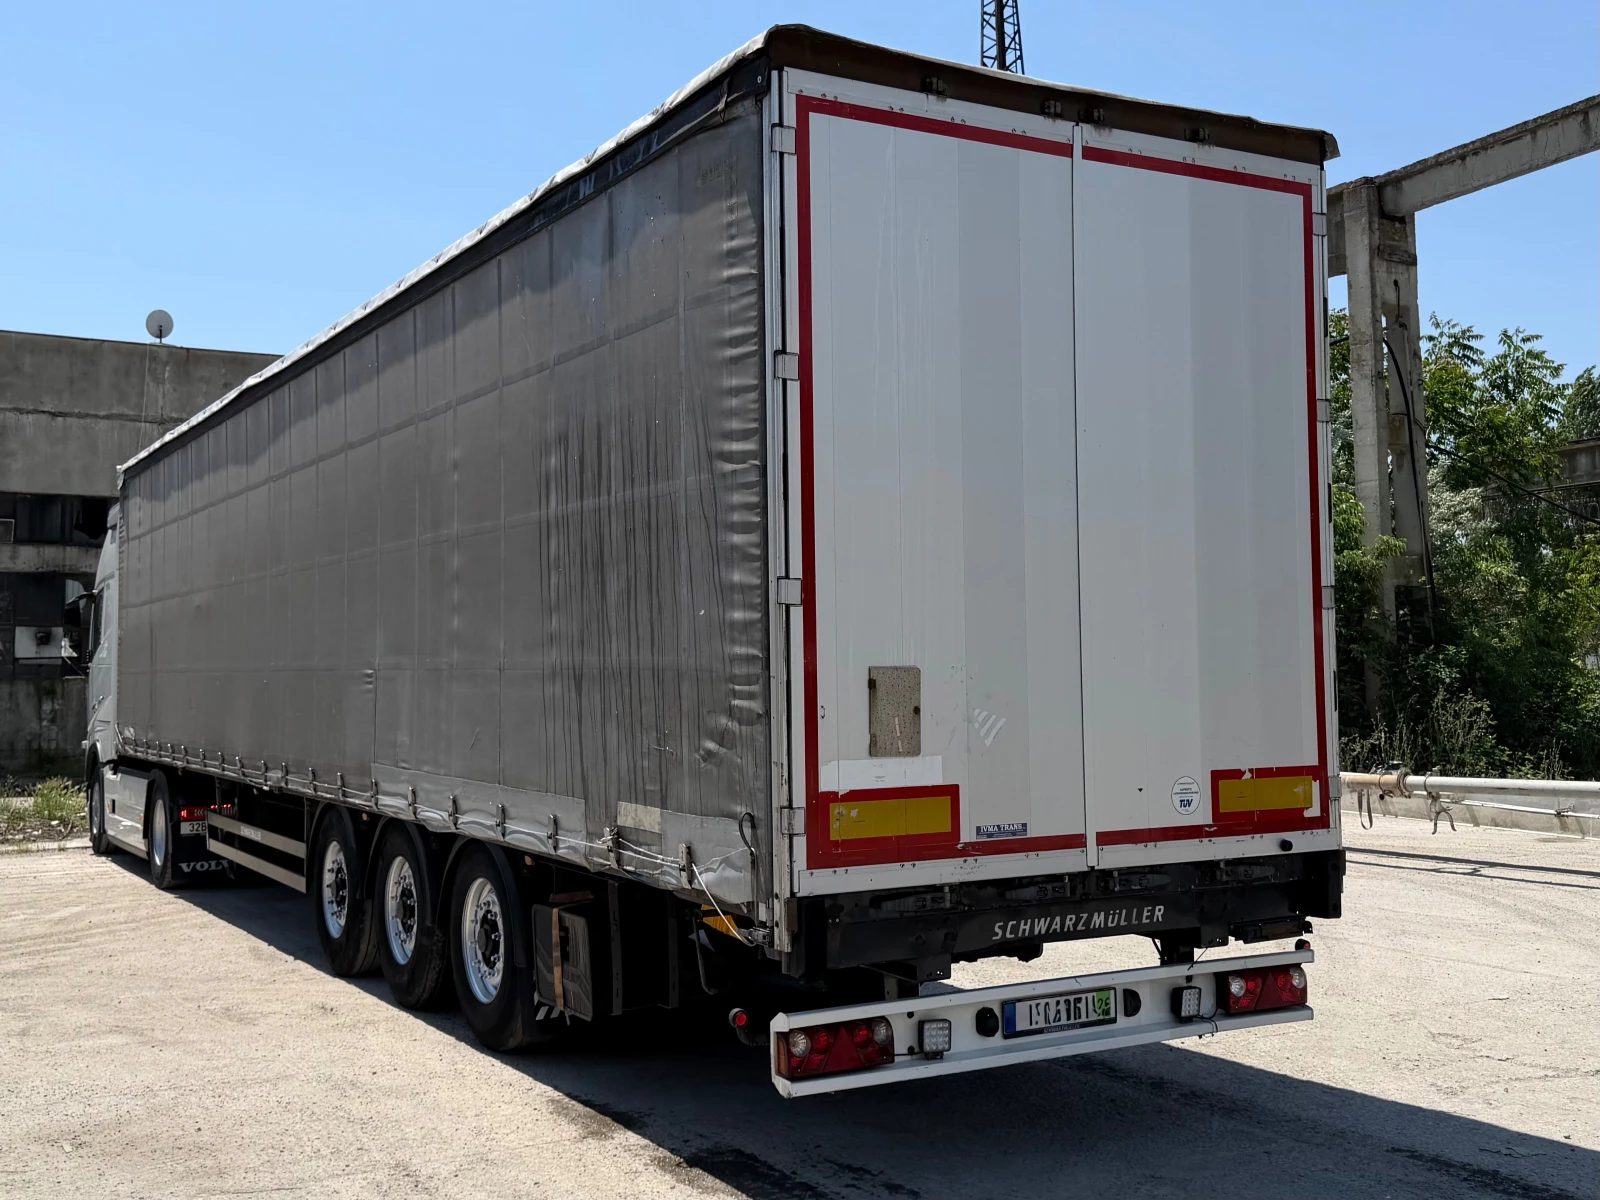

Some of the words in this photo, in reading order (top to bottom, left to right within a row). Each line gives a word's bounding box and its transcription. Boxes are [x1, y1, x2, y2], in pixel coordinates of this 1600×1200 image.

[980, 825, 998, 833] IVMA
[1000, 823, 1023, 831] TRANS
[992, 905, 1165, 940] SCHWARZMÜLLER
